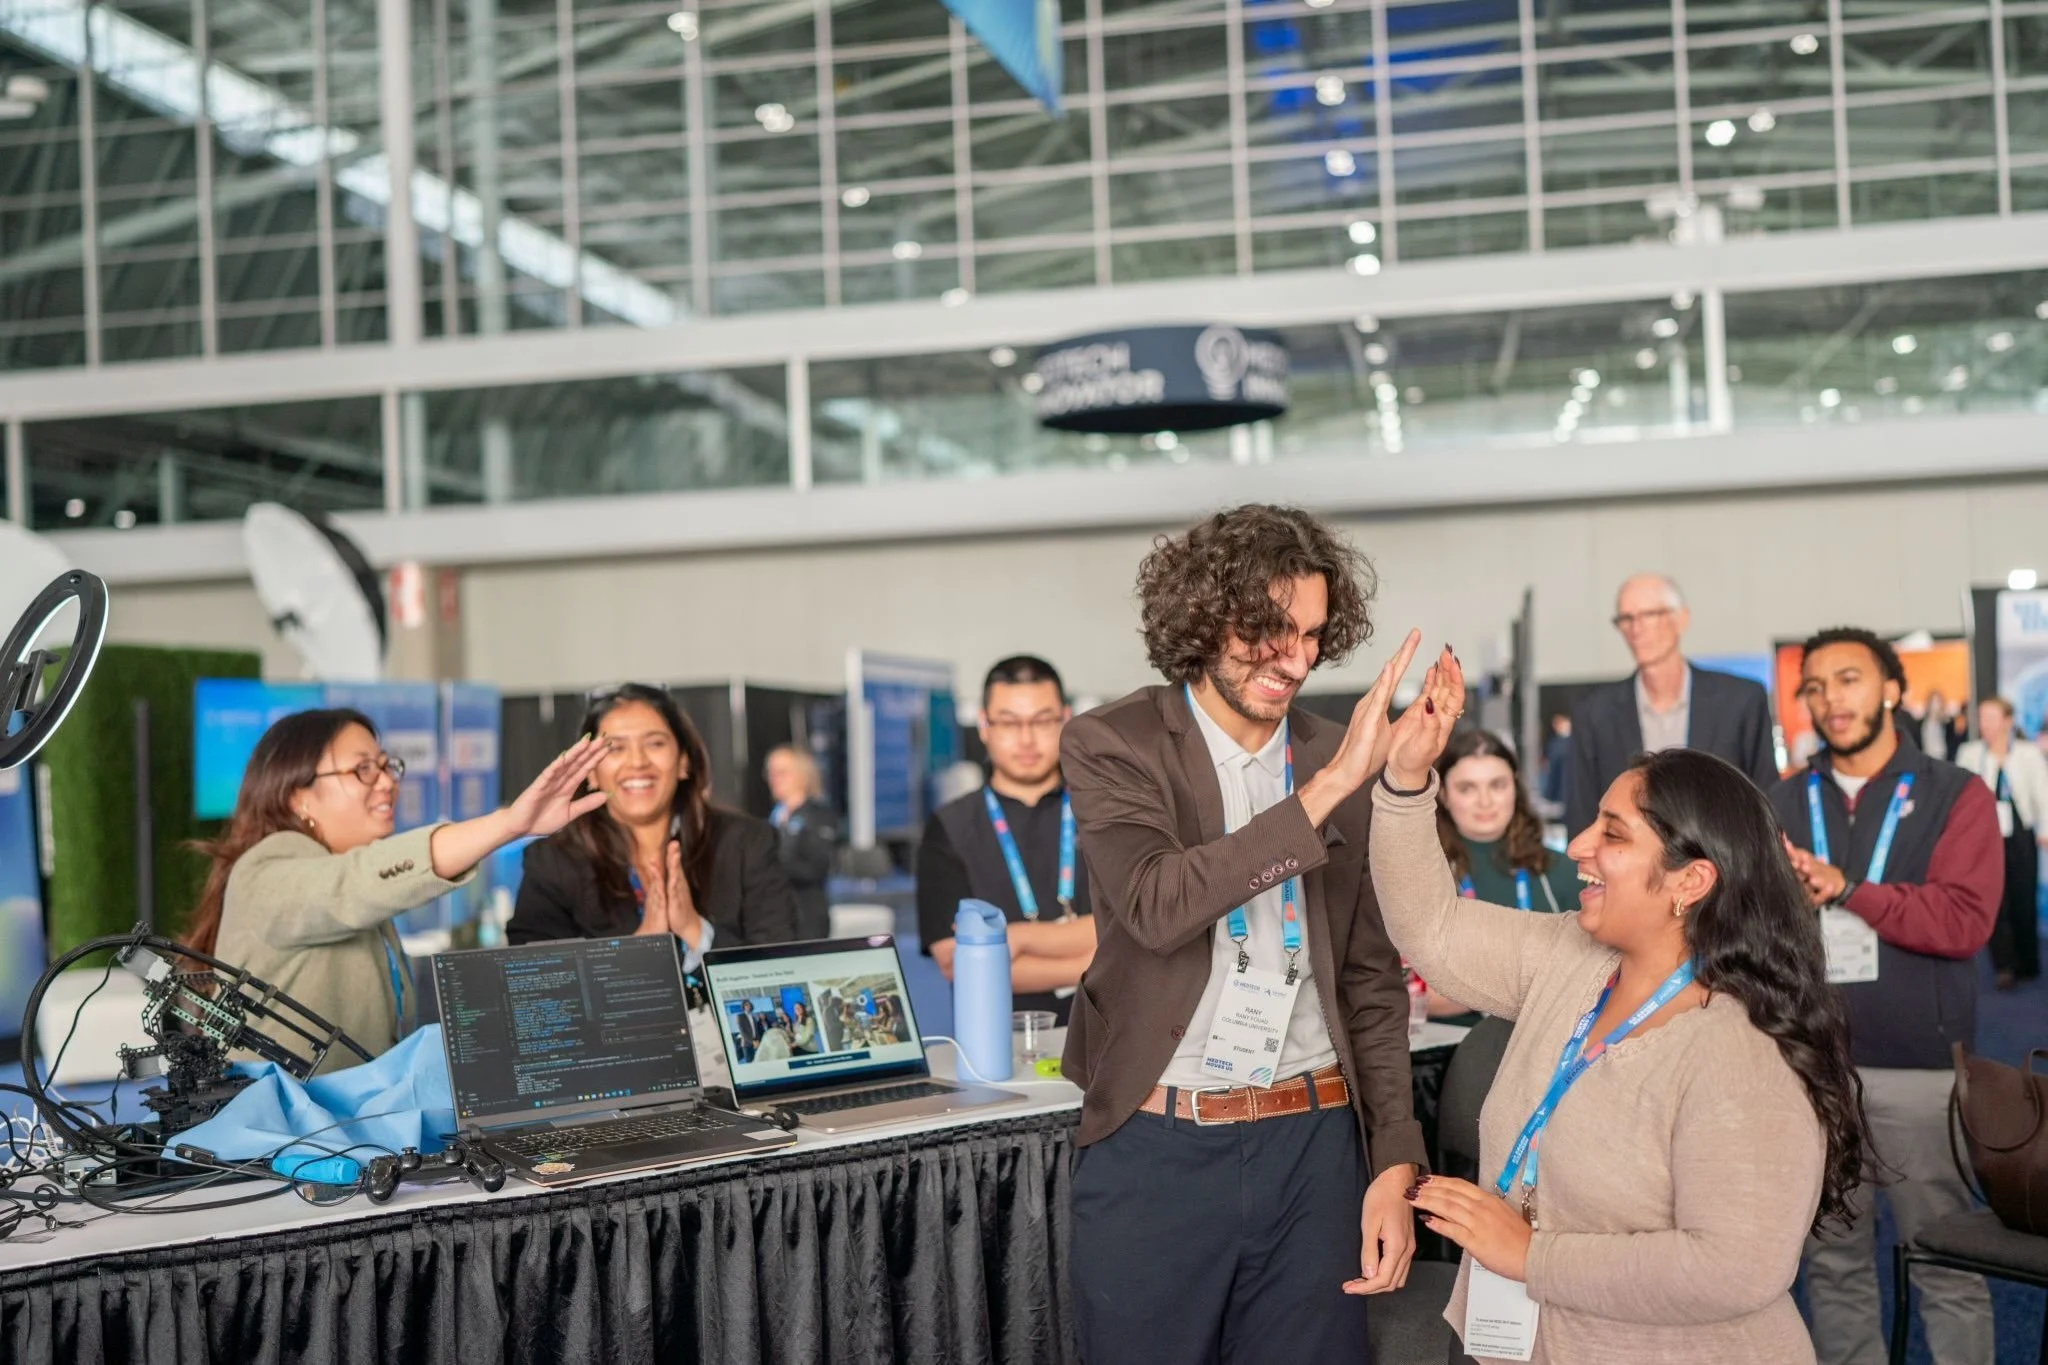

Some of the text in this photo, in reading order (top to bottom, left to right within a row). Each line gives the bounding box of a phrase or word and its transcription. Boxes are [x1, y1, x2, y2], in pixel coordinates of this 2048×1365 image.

[1245, 1006, 1263, 1015] RANY
[1221, 1016, 1279, 1033] COLUMBIA UNIVERSITY
[1233, 1045, 1255, 1054] STUDENT
[1205, 1062, 1225, 1070] MOVES
[1206, 1057, 1233, 1067] MEDTECH
